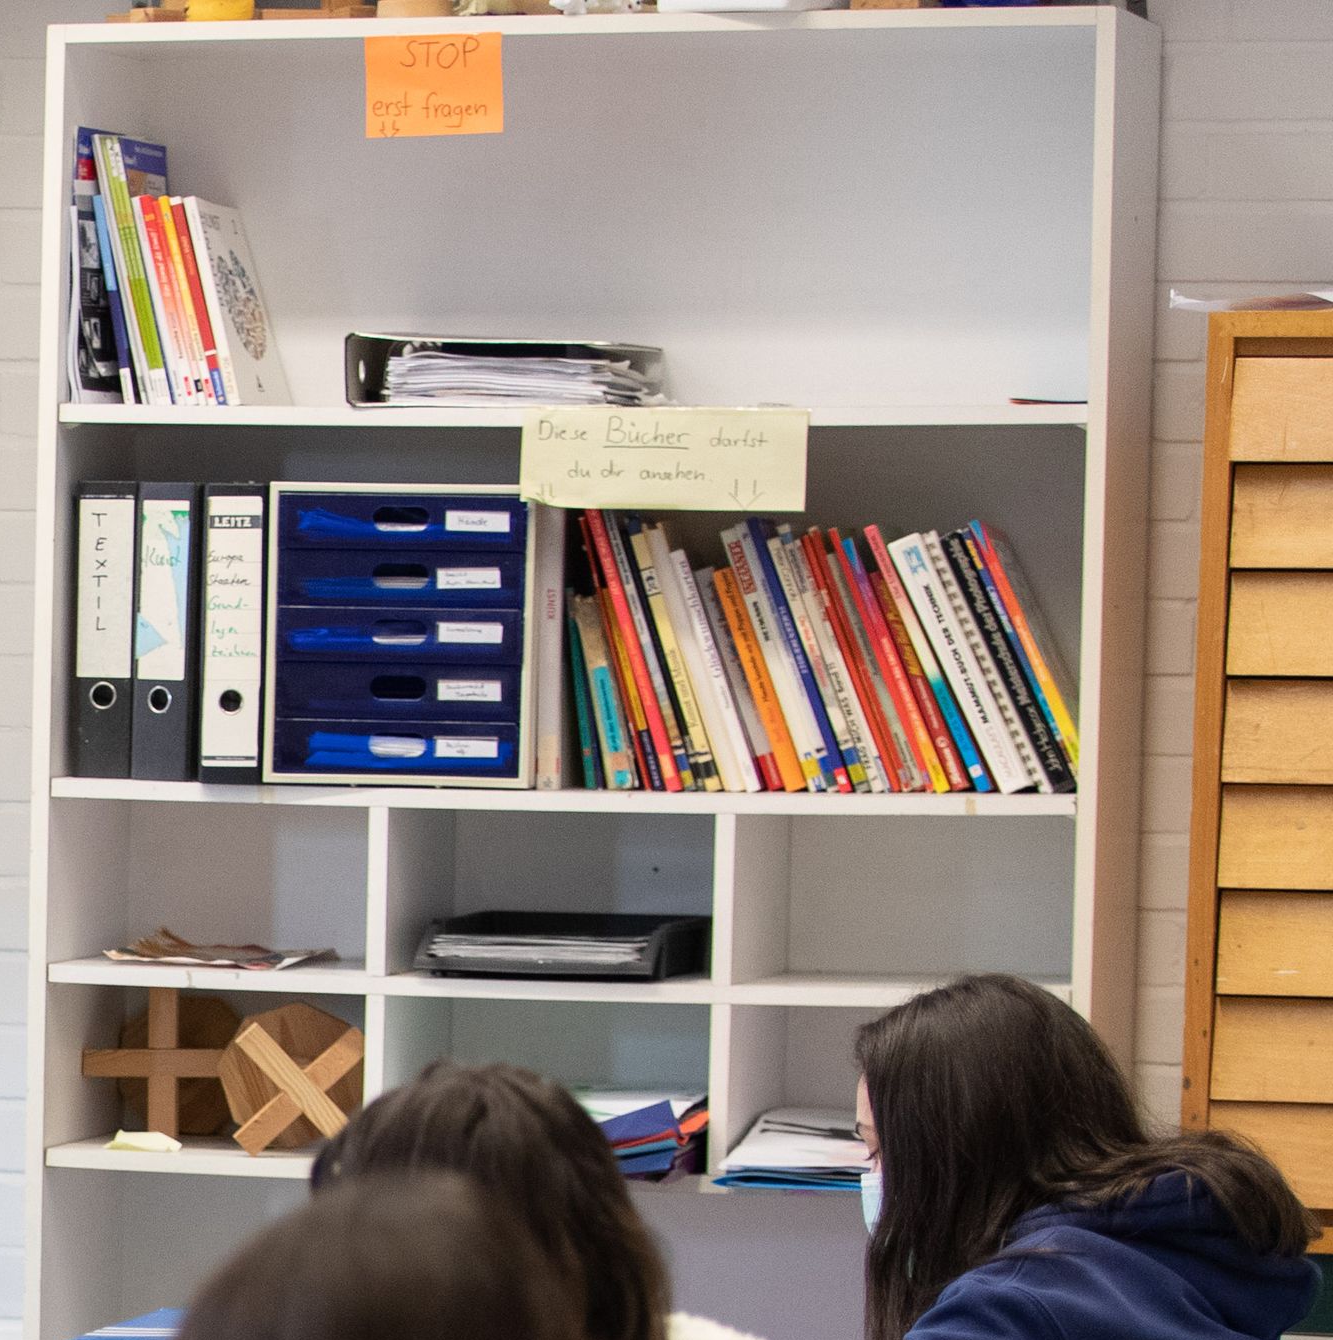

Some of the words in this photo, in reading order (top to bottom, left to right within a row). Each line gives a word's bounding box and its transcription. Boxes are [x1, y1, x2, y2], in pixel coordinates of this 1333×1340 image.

[399, 35, 480, 69] STOP
[372, 91, 413, 117] erst
[421, 91, 488, 128] fragen
[537, 420, 589, 442] Diese
[604, 415, 692, 446] Bücher
[709, 426, 770, 448] darfst
[567, 461, 592, 479] du
[600, 460, 624, 478] dir
[214, 516, 252, 528] LEITZ
[92, 512, 108, 631] TEXTIL
[546, 588, 556, 620] KUNST
[920, 583, 944, 624] TECHNIK
[940, 626, 954, 646] DER
